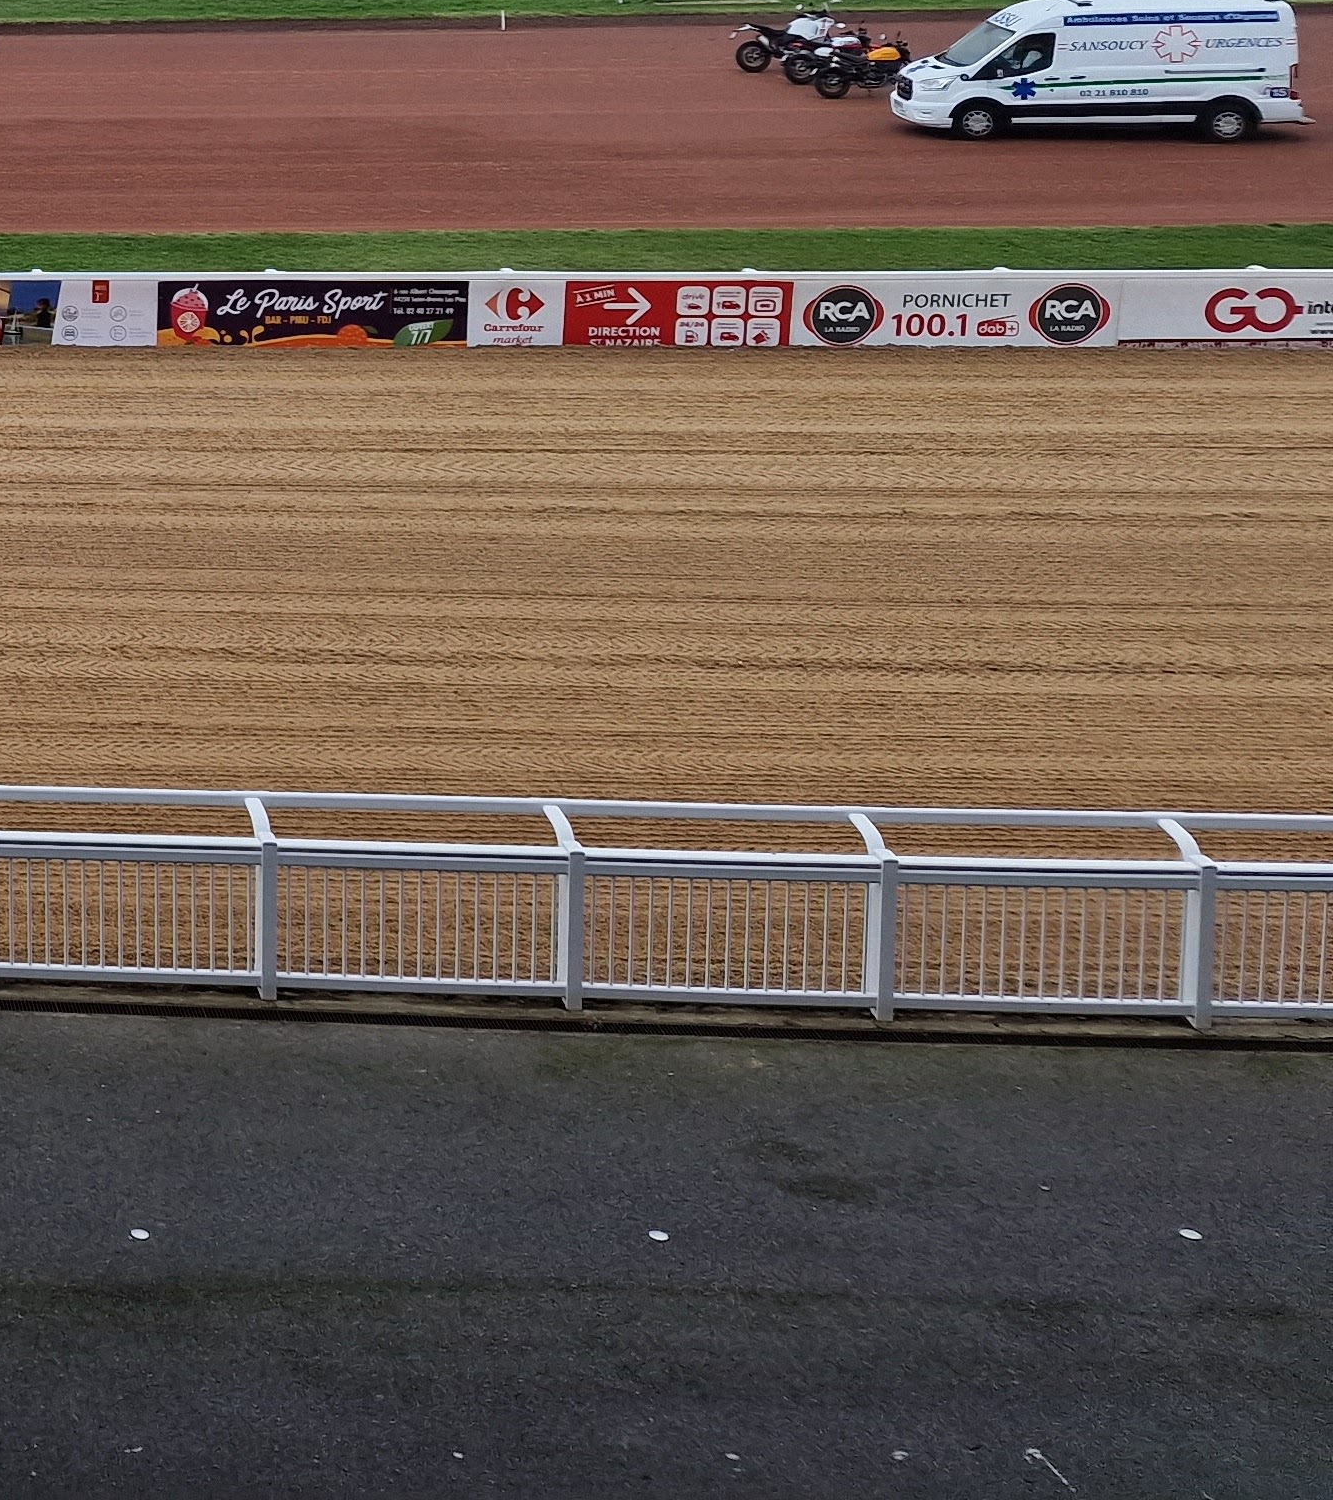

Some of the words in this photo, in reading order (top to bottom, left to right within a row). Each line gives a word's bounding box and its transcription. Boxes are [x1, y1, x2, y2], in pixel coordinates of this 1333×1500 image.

[1069, 40, 1149, 51] SANSOUCY
[1205, 38, 1283, 49] URGENCES
[593, 288, 616, 299] MIN
[216, 288, 251, 315] Le
[254, 289, 319, 318] Paris
[322, 289, 389, 319] Sport
[902, 294, 1012, 308] PORNICHET
[819, 301, 871, 322] RCA
[1044, 300, 1097, 321] RCA
[1307, 300, 1333, 314] int
[264, 315, 282, 324] BAR
[316, 315, 331, 324] FDJ
[891, 313, 968, 337] 100.1
[483, 324, 544, 332] Carrefour
[588, 326, 661, 337] DIRECTION
[492, 336, 534, 344] market
